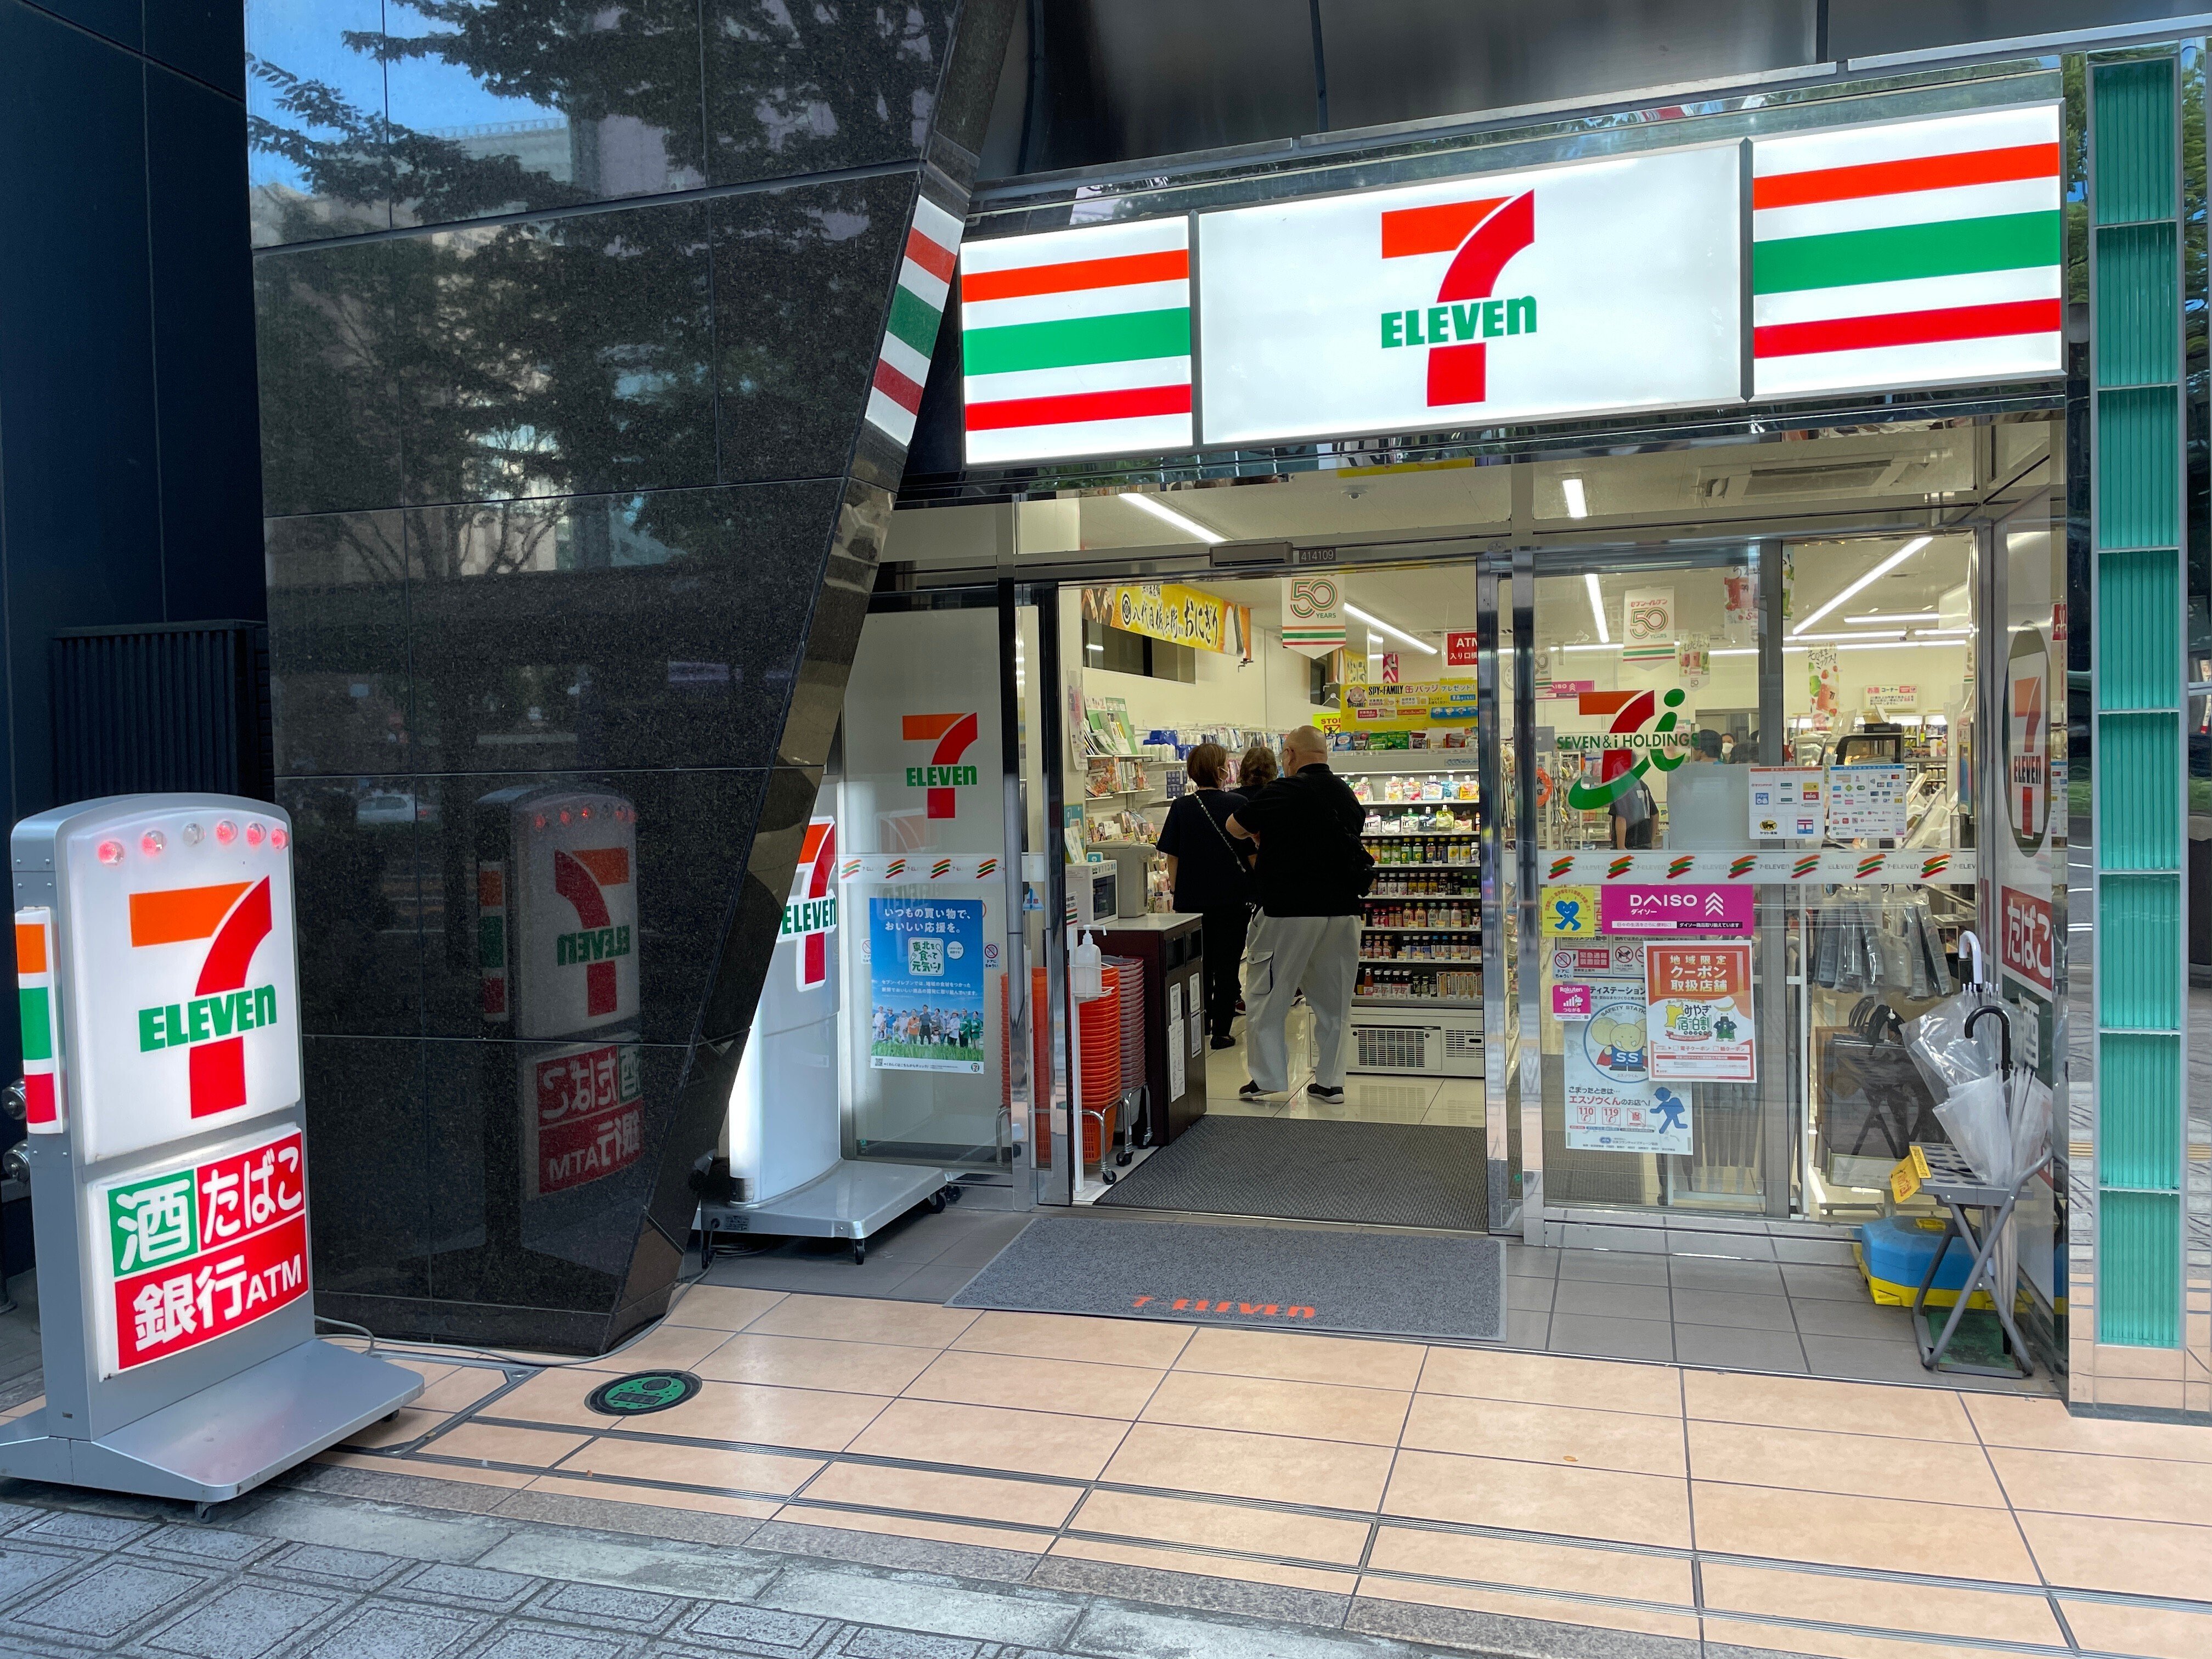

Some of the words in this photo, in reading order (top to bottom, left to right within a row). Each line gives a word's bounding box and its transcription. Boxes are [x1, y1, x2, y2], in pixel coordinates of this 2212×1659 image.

[1301, 550, 1334, 562] 414109
[1290, 579, 1338, 619] 50
[1184, 597, 1218, 646] おにぎり
[1630, 607, 1668, 640] 50
[1405, 684, 1439, 693] 缶バッジ
[1622, 733, 1699, 747] HOLDINGS
[1630, 894, 1698, 907] DAISO
[884, 907, 971, 919] いつもの買い物で、
[885, 922, 960, 933] おいしい応援を。
[2007, 898, 2051, 979] たばこ
[1669, 955, 1726, 965] 地域限定
[1671, 966, 1727, 979] クーポン
[1671, 979, 1728, 992] 取扱店舗
[1601, 1005, 1623, 1017] SAFETY
[1684, 1004, 1712, 1017] みやぎ
[1677, 1015, 1712, 1031] 宿泊割
[1616, 1052, 1639, 1063] SS
[1578, 1107, 1594, 1115] 110
[1603, 1108, 1619, 1116] 119
[116, 1178, 191, 1271] 酒
[202, 1146, 302, 1244] たばこ
